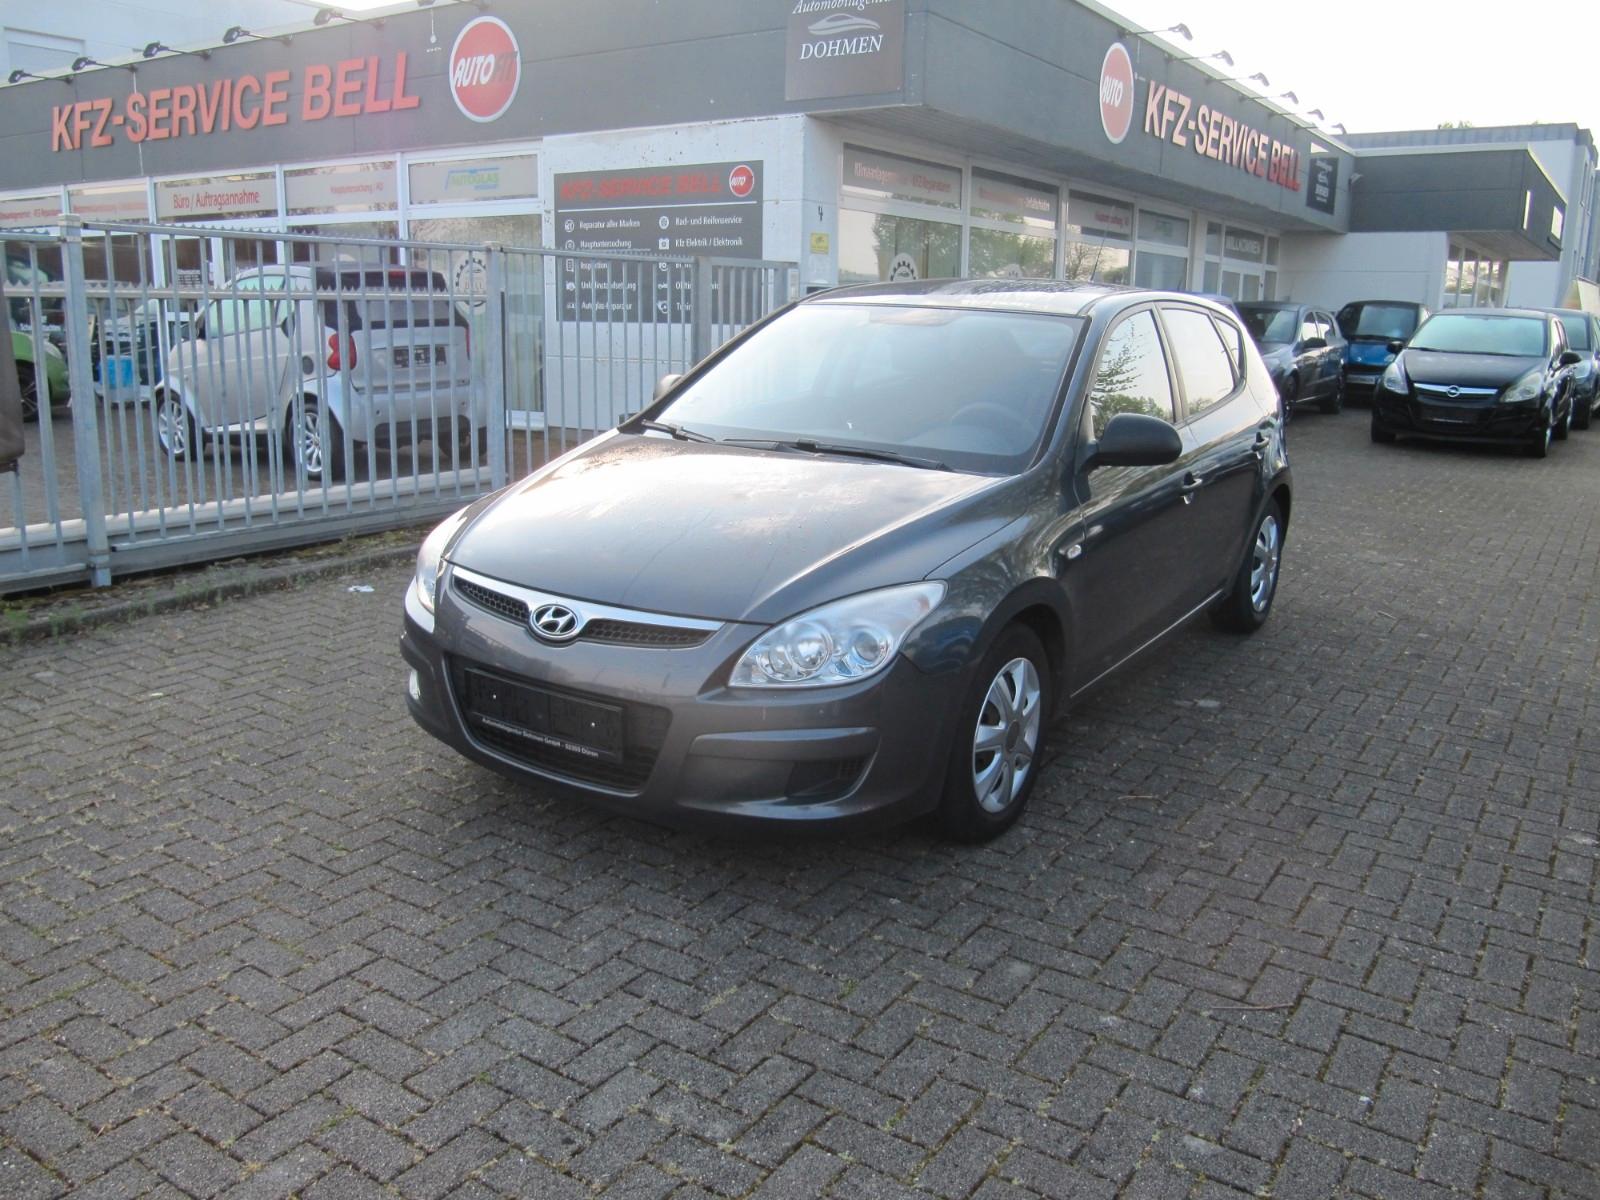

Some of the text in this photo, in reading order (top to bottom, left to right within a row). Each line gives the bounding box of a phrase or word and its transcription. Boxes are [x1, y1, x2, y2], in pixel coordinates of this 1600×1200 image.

[800, 34, 883, 60] DOHMEN
[52, 51, 420, 152] KFZ-SERVICE BELL
[1144, 79, 1301, 192] KFZ-SERVICE BELL
[173, 193, 190, 209] Büro
[195, 189, 260, 211] Auftragsannahme
[690, 216, 703, 224] und
[703, 216, 743, 225] Reifenservice
[818, 205, 823, 221] 4
[579, 219, 640, 231] Reparatur aller Marken
[675, 239, 685, 247] Kfz
[686, 238, 708, 247] Elektrik
[713, 237, 743, 246] Elektronik
